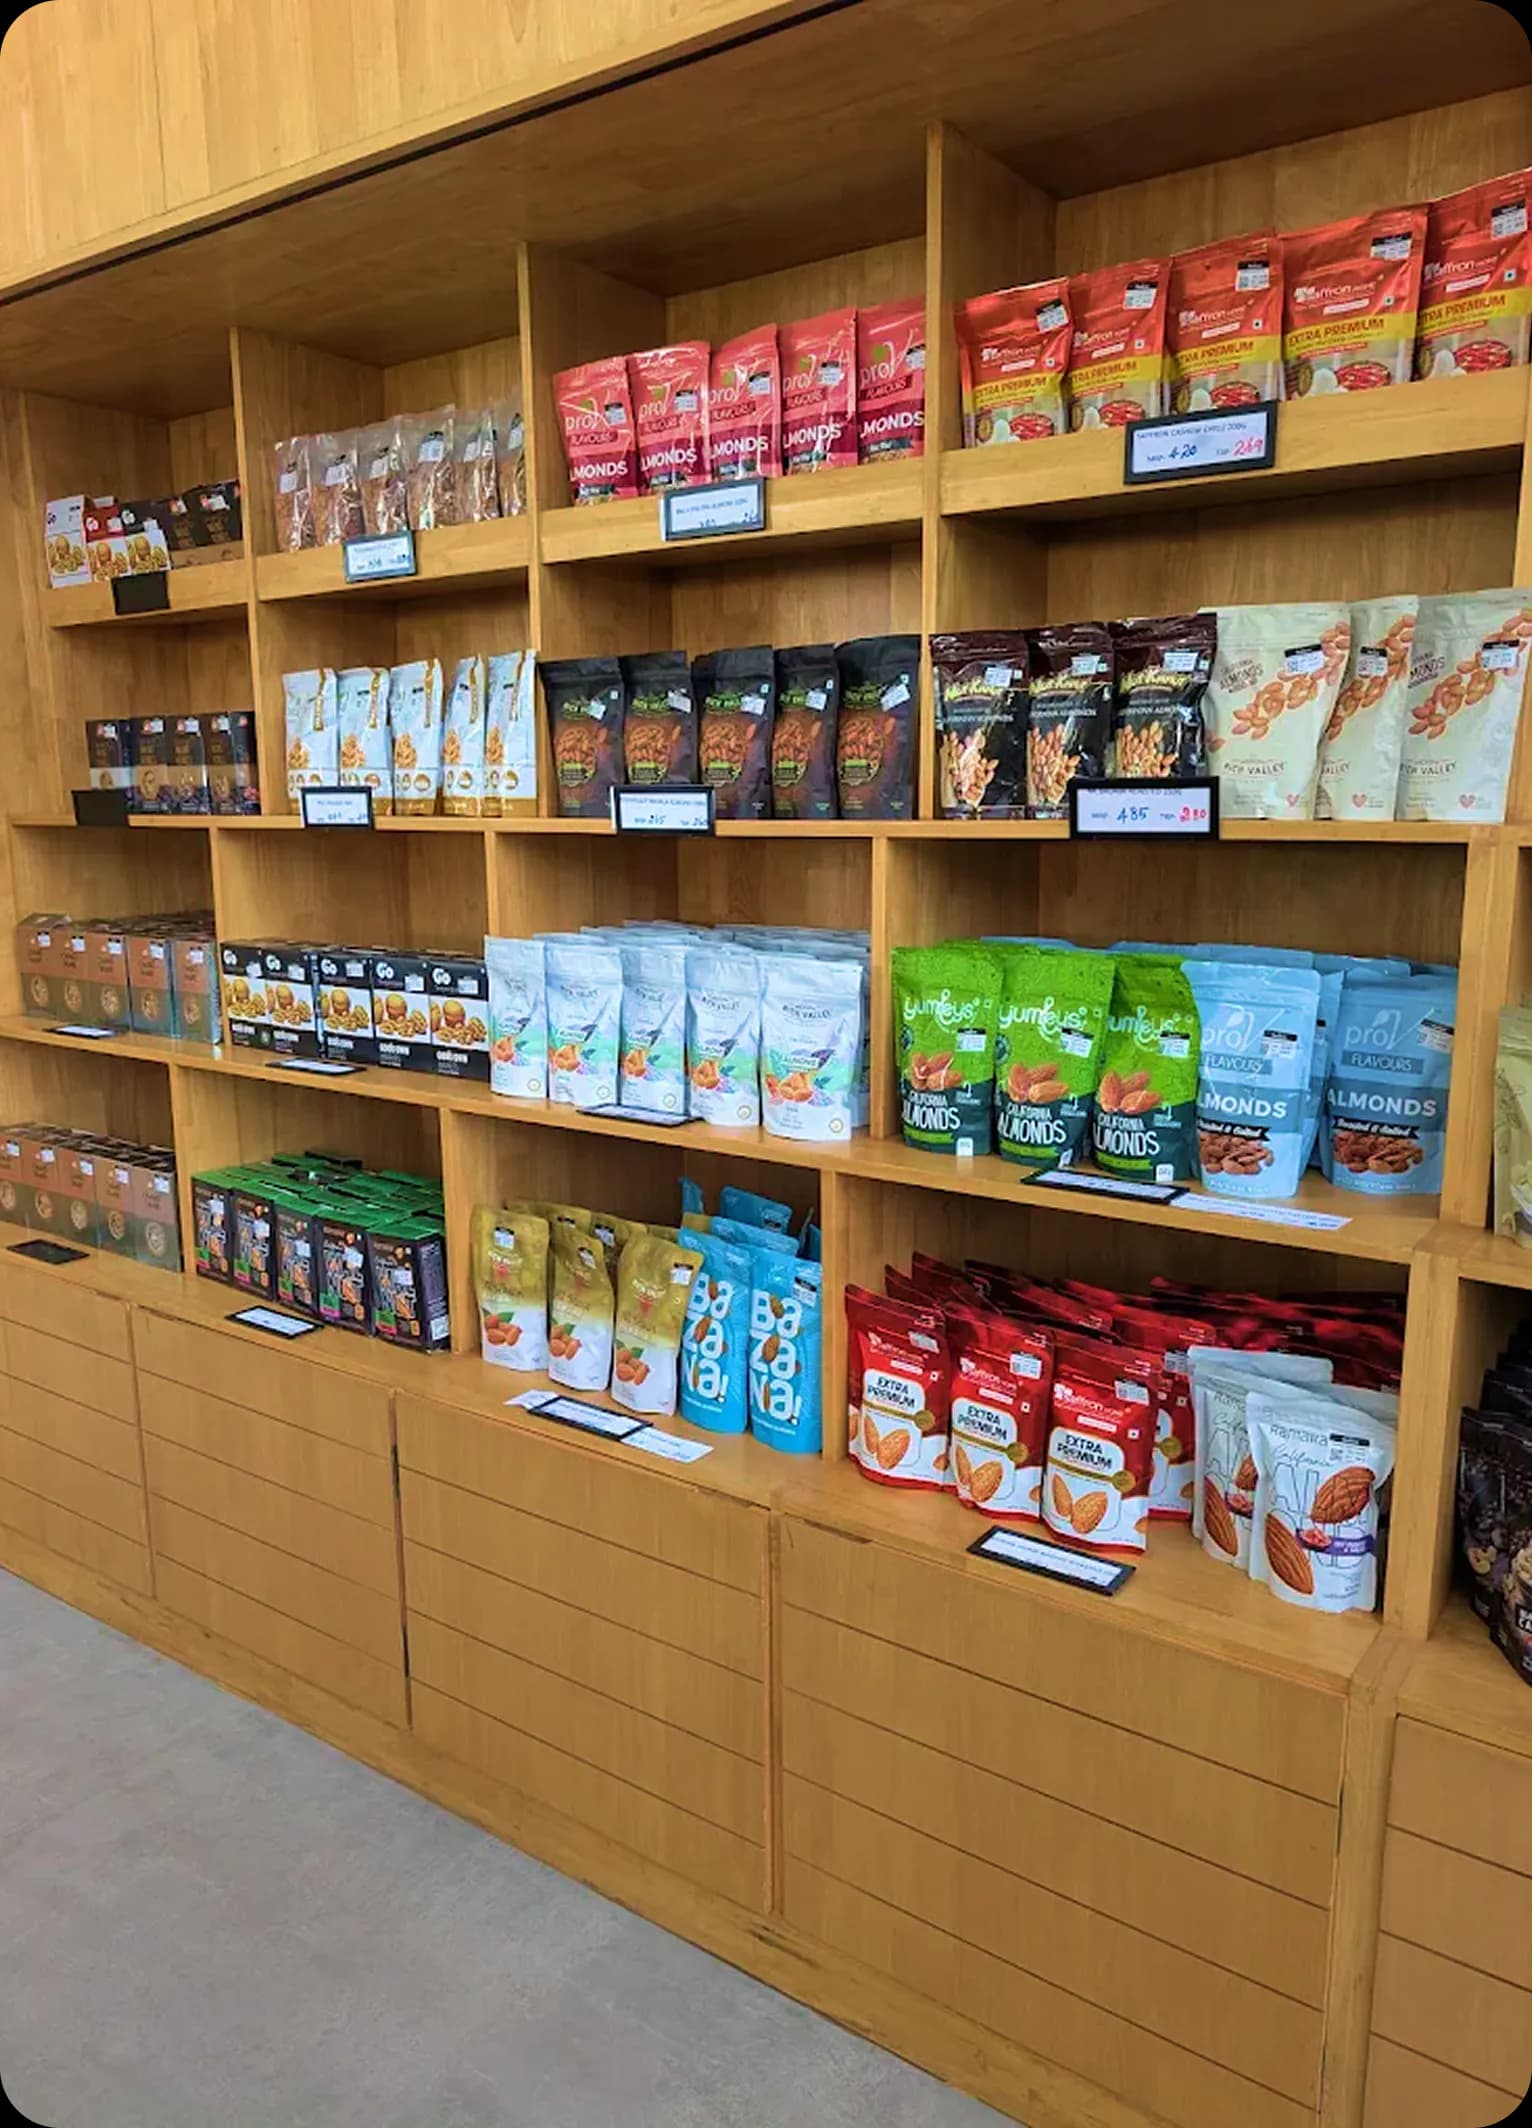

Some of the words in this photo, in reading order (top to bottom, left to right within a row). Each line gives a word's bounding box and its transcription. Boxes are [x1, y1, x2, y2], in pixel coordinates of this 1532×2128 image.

[1446, 294, 1505, 316] PREMIUM
[1325, 318, 1384, 336] PREMIUM
[783, 424, 842, 449] LMONDS
[641, 448, 697, 471] LMONDS
[569, 461, 628, 481] LMONDS
[1321, 763, 1350, 775] ALLEY
[1116, 806, 1149, 824] 485
[265, 954, 281, 971] Go
[321, 958, 338, 976] Go
[376, 962, 395, 979] Go
[432, 968, 451, 986] Go
[1351, 1053, 1412, 1073] FLAVOURS
[1327, 1088, 1438, 1117] ALMONDS
[877, 1375, 909, 1395] EXTRA
[867, 1384, 915, 1408] PREMIUM
[968, 1405, 1001, 1425] EXTRA
[957, 1414, 1008, 1440] PREMIUM
[1066, 1434, 1102, 1455] EXTRA
[1057, 1442, 1112, 1469] PREMIUM
